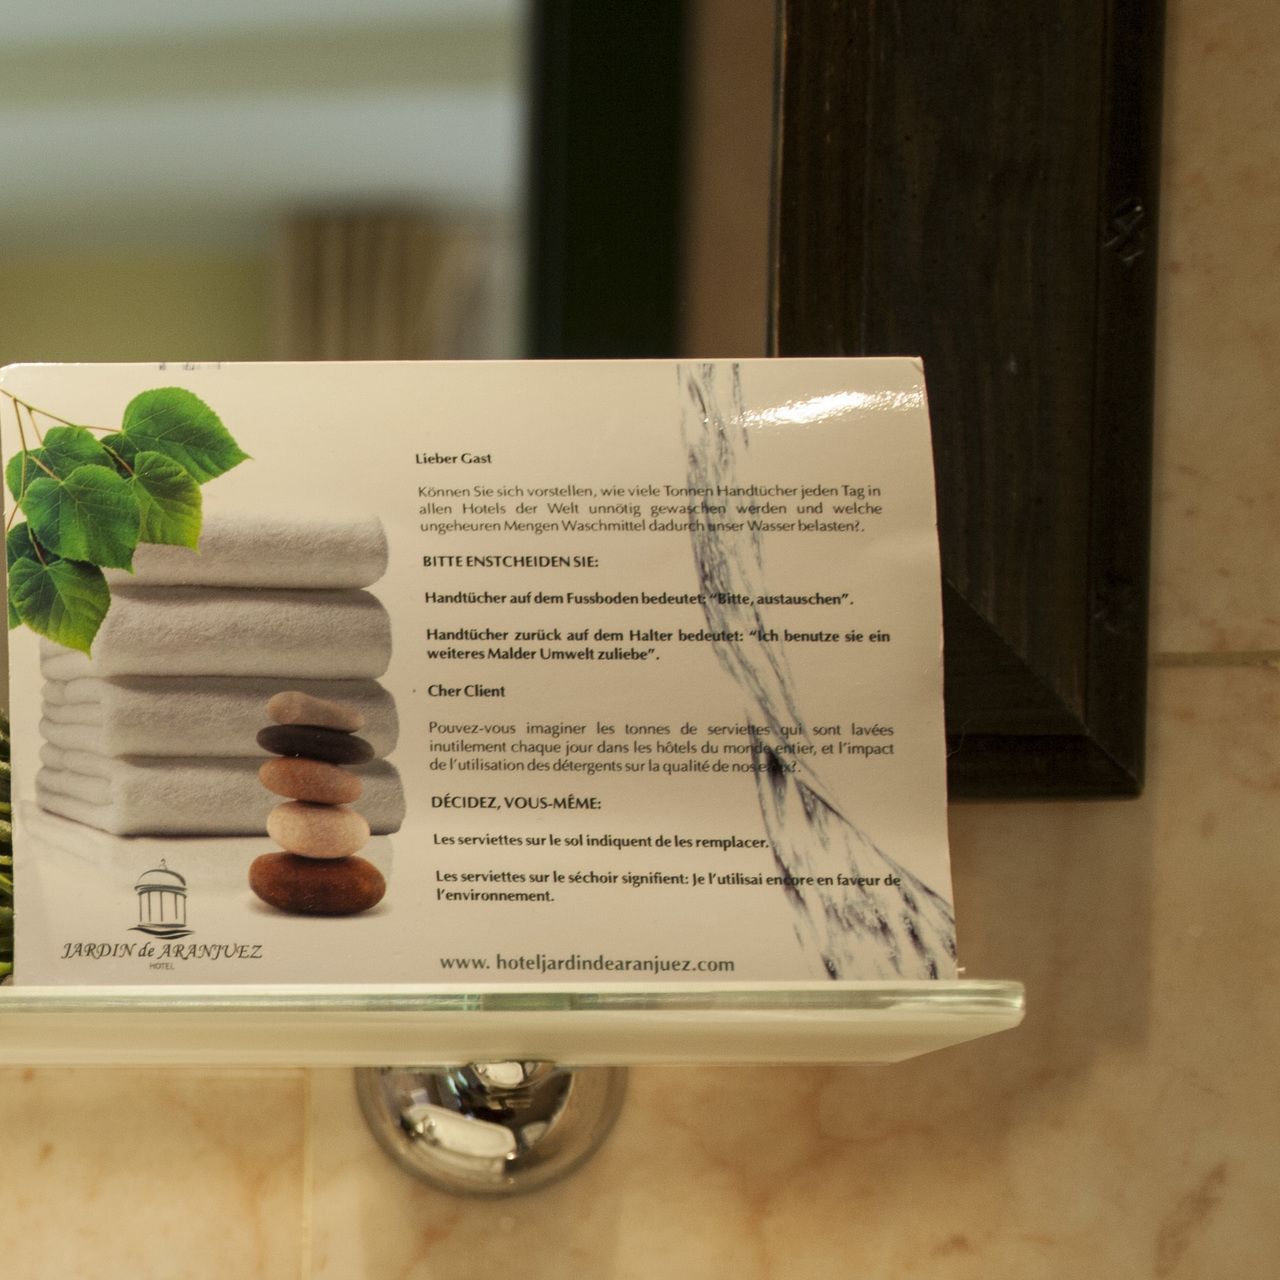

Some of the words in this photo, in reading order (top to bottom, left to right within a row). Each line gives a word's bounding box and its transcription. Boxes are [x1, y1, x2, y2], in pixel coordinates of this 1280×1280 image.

[415, 454, 457, 464] Lieber
[461, 454, 492, 464] Gast
[418, 486, 470, 497] Können
[474, 486, 493, 497] Sie
[497, 486, 523, 497] sich
[526, 486, 596, 499] vorstellen,
[600, 486, 624, 497] wie
[628, 486, 660, 497] viele
[664, 486, 713, 497] Tonnen
[717, 486, 797, 497] Handtücher
[800, 485, 838, 499] jeden
[842, 486, 865, 500] Tag
[868, 486, 880, 497] in
[419, 503, 452, 514] allen
[463, 503, 506, 514] Hotels
[516, 503, 537, 514] der
[548, 503, 579, 514] Welt
[589, 503, 641, 518] unnötig
[651, 503, 726, 518] gewaschen
[737, 503, 786, 514] werden
[797, 503, 823, 514] und
[833, 503, 882, 514] welche
[421, 520, 501, 535] ungeheuren
[504, 521, 558, 535] Mengen
[562, 520, 645, 531] Waschmittel
[649, 520, 705, 531] dadurch
[708, 522, 744, 531] unser
[747, 520, 794, 531] Wasser
[423, 556, 462, 567] BITTE
[466, 556, 571, 567] ENSTCHEIDEN
[573, 556, 598, 567] SIE:
[425, 592, 506, 604] Handtücher
[509, 592, 530, 604] auf
[534, 592, 564, 604] dem
[567, 592, 638, 604] Fussboden
[642, 592, 706, 604] bedeutet:
[427, 629, 508, 641] Handtücher
[515, 629, 560, 641] zurück
[567, 629, 588, 641] auf
[594, 629, 623, 641] dem
[629, 629, 672, 641] Halter
[678, 629, 743, 641] bedeutet:
[784, 629, 839, 641] benutze
[845, 629, 863, 641] sie
[869, 629, 890, 641] ein
[428, 647, 485, 660] weiteres
[540, 647, 594, 660] Umwelt
[428, 685, 461, 697] Cher
[464, 685, 505, 697] Client
[429, 723, 516, 735] Pouvez-vous
[527, 723, 586, 738] imaginer
[597, 723, 615, 735] les
[625, 725, 670, 735] tonnes
[681, 723, 698, 735] de
[708, 723, 769, 735] serviettes
[781, 724, 802, 739] qui
[813, 725, 841, 736] sont
[852, 723, 894, 735] lavées
[429, 741, 506, 753] inutilement
[511, 741, 561, 756] chaque
[565, 742, 593, 756] jour
[597, 741, 629, 753] dans
[634, 741, 651, 753] les
[656, 741, 697, 753] hôtels
[702, 741, 719, 753] du
[723, 741, 770, 753] monde
[775, 743, 817, 756] entier,
[821, 744, 834, 754] et
[429, 760, 446, 772] de
[527, 760, 550, 772] des
[553, 760, 622, 775] détergents
[625, 763, 645, 772] sur
[648, 760, 659, 772] la
[663, 760, 709, 775] qualité
[712, 760, 729, 772] de
[732, 763, 755, 773] nos
[432, 795, 500, 811] DÉCIDEZ,
[505, 795, 601, 809] VOUS-MÊME:
[434, 835, 455, 847] Les
[457, 835, 522, 847] serviettes
[526, 837, 545, 847] sur
[549, 835, 561, 847] le
[564, 835, 583, 847] sol
[586, 836, 652, 851] indiquent
[655, 835, 672, 847] de
[674, 835, 692, 847] les
[695, 837, 768, 851] remplacer.
[436, 871, 457, 884] Les
[460, 871, 525, 884] serviettes
[529, 874, 550, 884] sur
[553, 871, 565, 884] le
[568, 871, 618, 884] séchoir
[622, 872, 689, 888] signifient:
[692, 871, 704, 884] Je
[766, 874, 816, 886] encore
[819, 876, 833, 886] en
[837, 873, 880, 886] faveur
[884, 873, 901, 886] de
[61, 942, 136, 959] JARDIN
[138, 942, 155, 958] de
[157, 943, 263, 960] ARANJUEZ
[149, 962, 175, 970] HOTEL
[440, 958, 489, 970] www.
[496, 954, 734, 973] hoteljardindearanjuez.com
